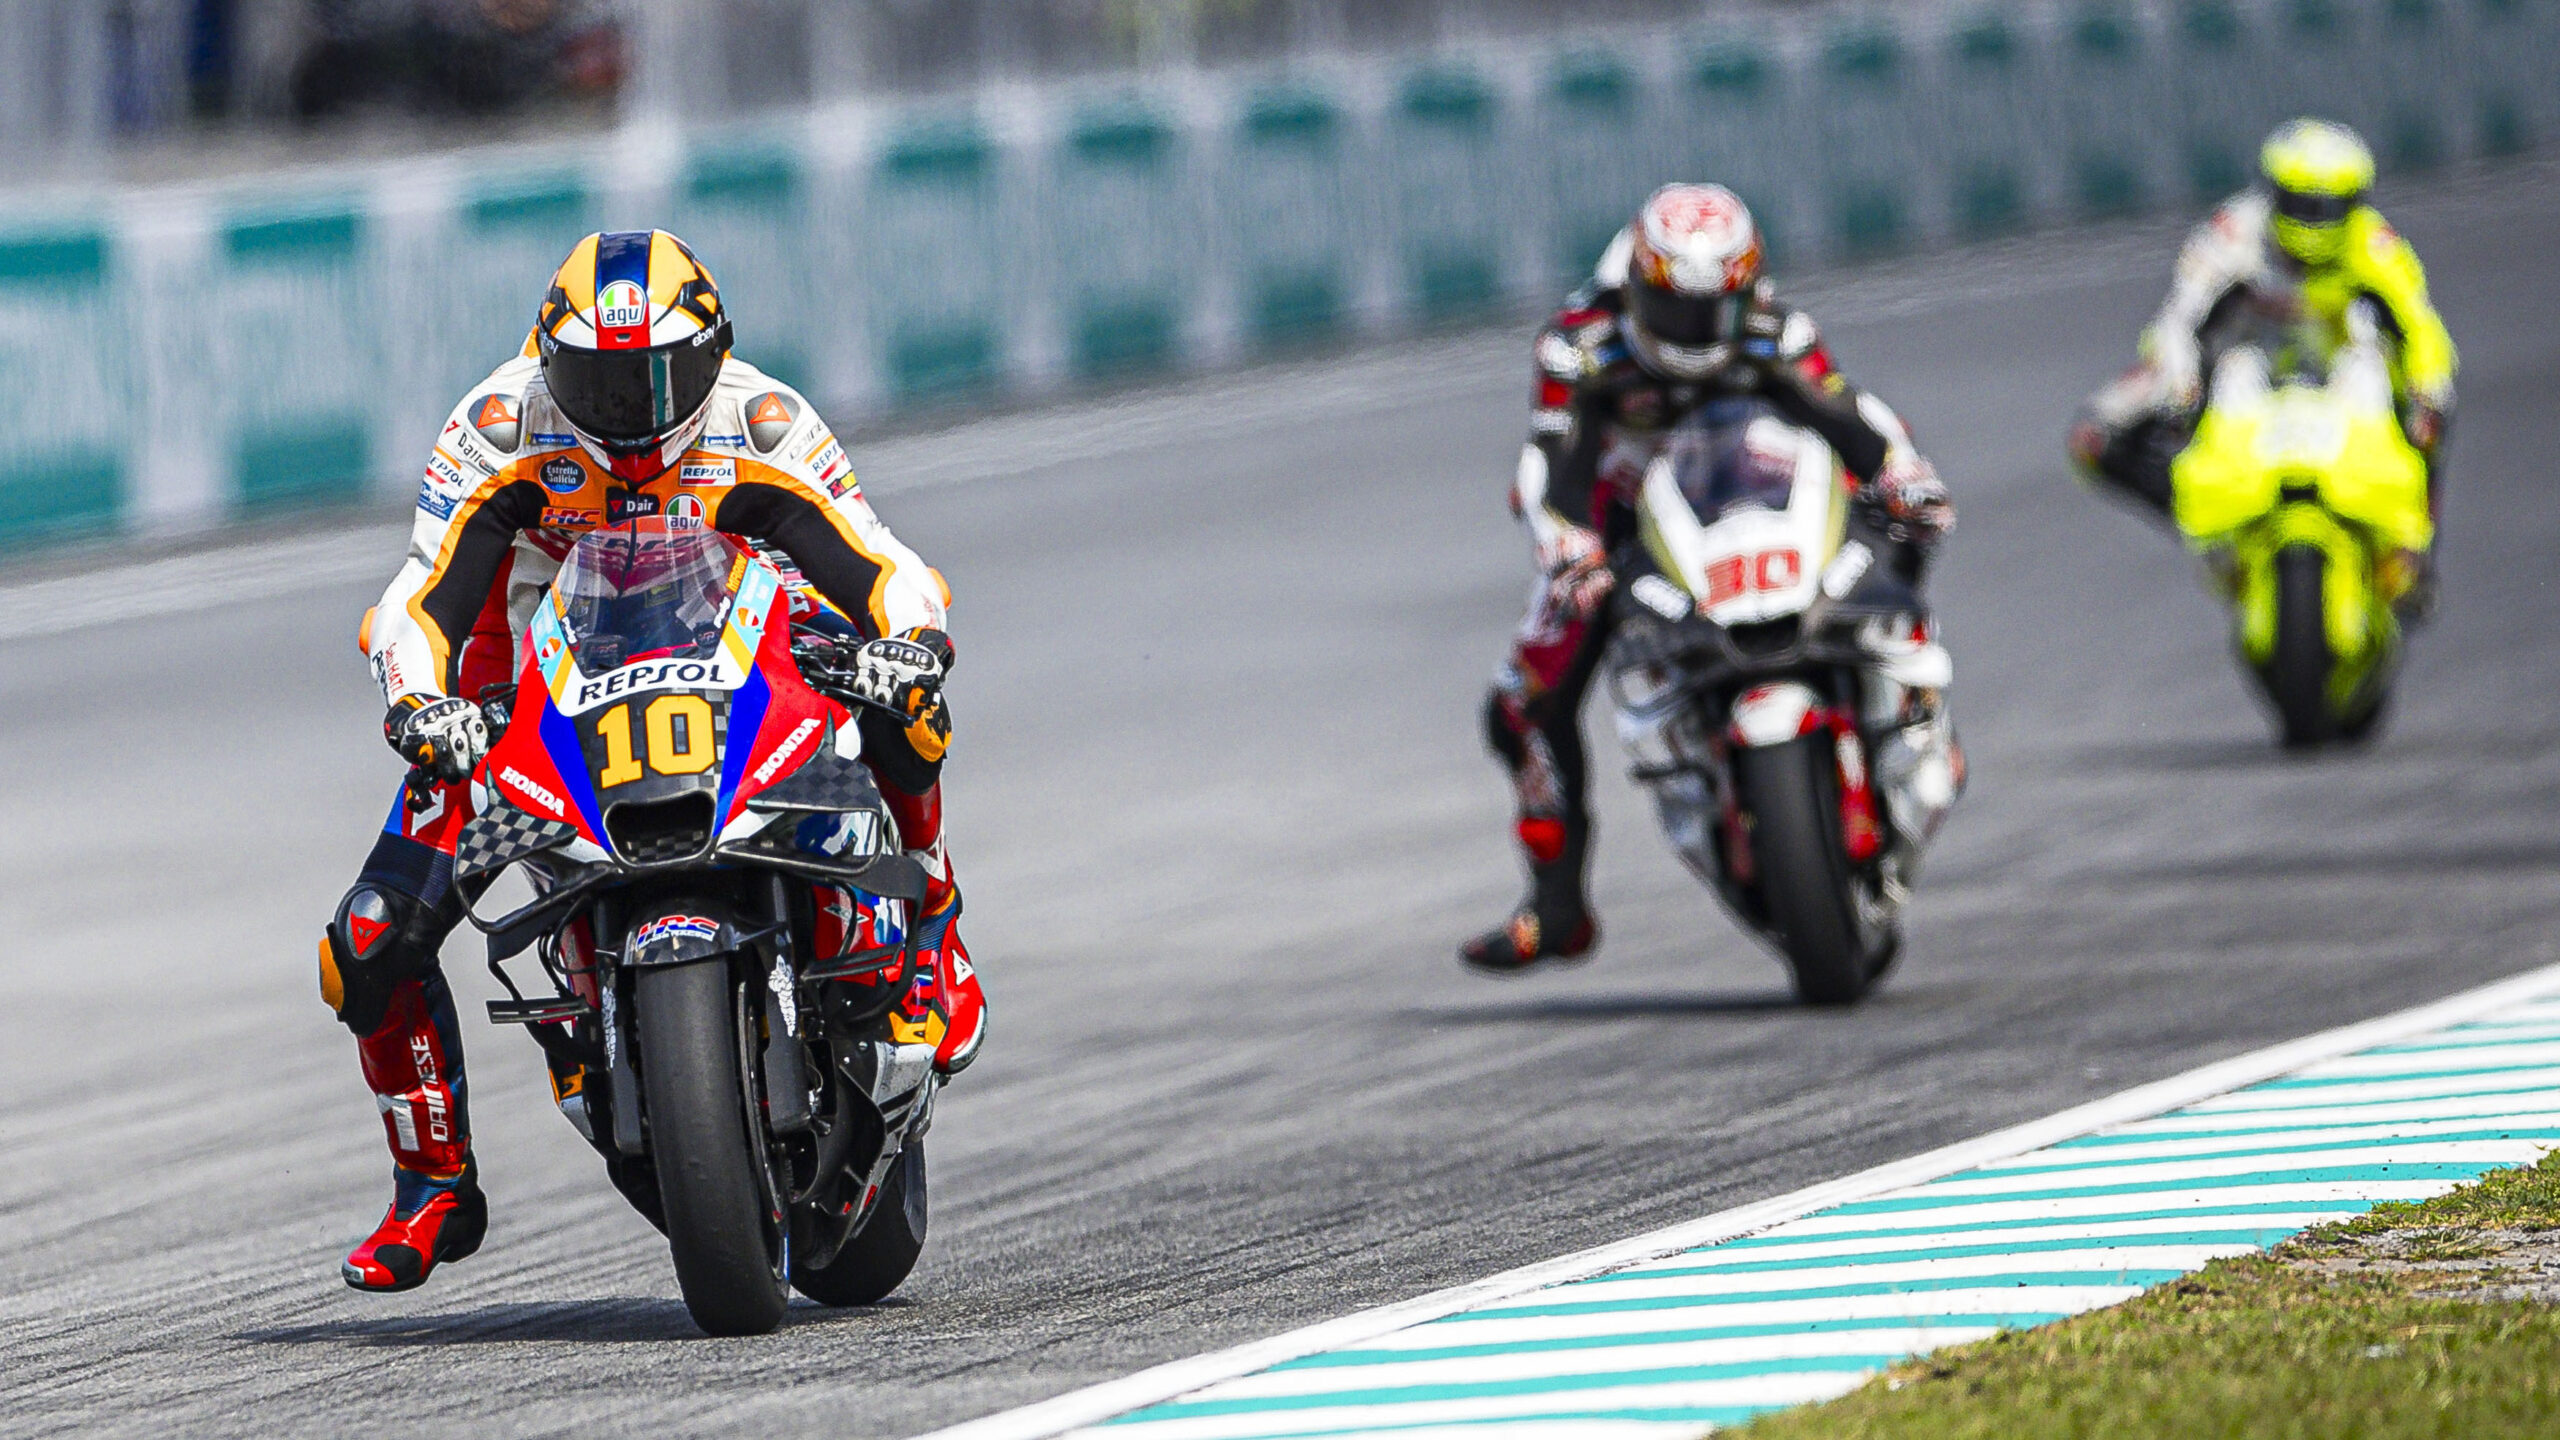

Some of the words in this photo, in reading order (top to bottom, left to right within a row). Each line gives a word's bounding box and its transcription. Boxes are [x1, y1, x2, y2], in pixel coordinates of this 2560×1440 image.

[605, 307, 639, 324] agv
[429, 456, 465, 488] EPSOL
[547, 464, 578, 476] Estrella
[682, 467, 732, 478] REPSOL
[542, 508, 602, 525] HRC
[670, 516, 699, 530] agv
[1698, 549, 1800, 613] 30
[578, 663, 725, 706] REPSOL
[597, 695, 716, 788] 10
[753, 718, 821, 784] HONDA
[499, 766, 565, 817] HONDA
[635, 914, 720, 950] HRC
